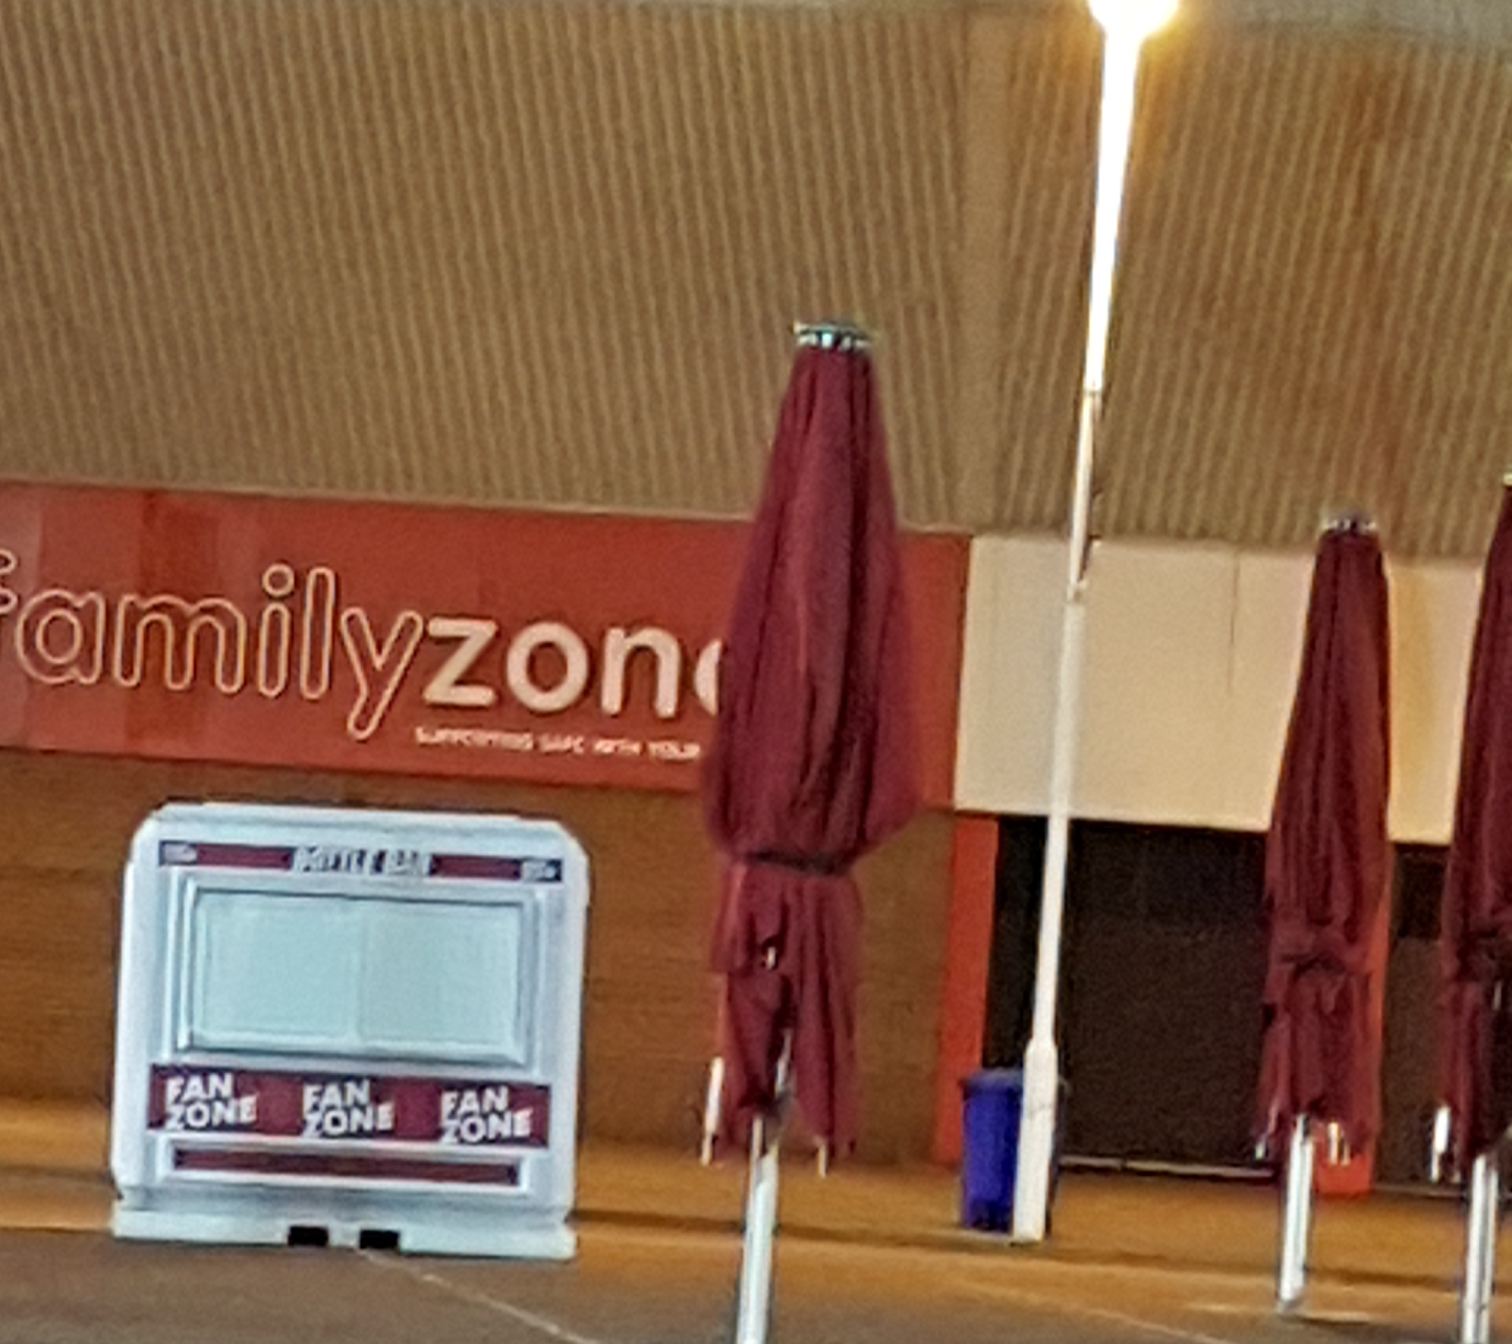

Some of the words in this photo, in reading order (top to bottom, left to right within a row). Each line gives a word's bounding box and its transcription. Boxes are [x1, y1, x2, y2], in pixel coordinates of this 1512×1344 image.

[165, 1072, 234, 1106] FAN
[302, 1079, 371, 1111] FAN
[440, 1085, 510, 1119] FAN
[164, 1093, 258, 1131] ZONE
[302, 1101, 395, 1139] ZONE
[440, 1106, 533, 1144] ZONE
